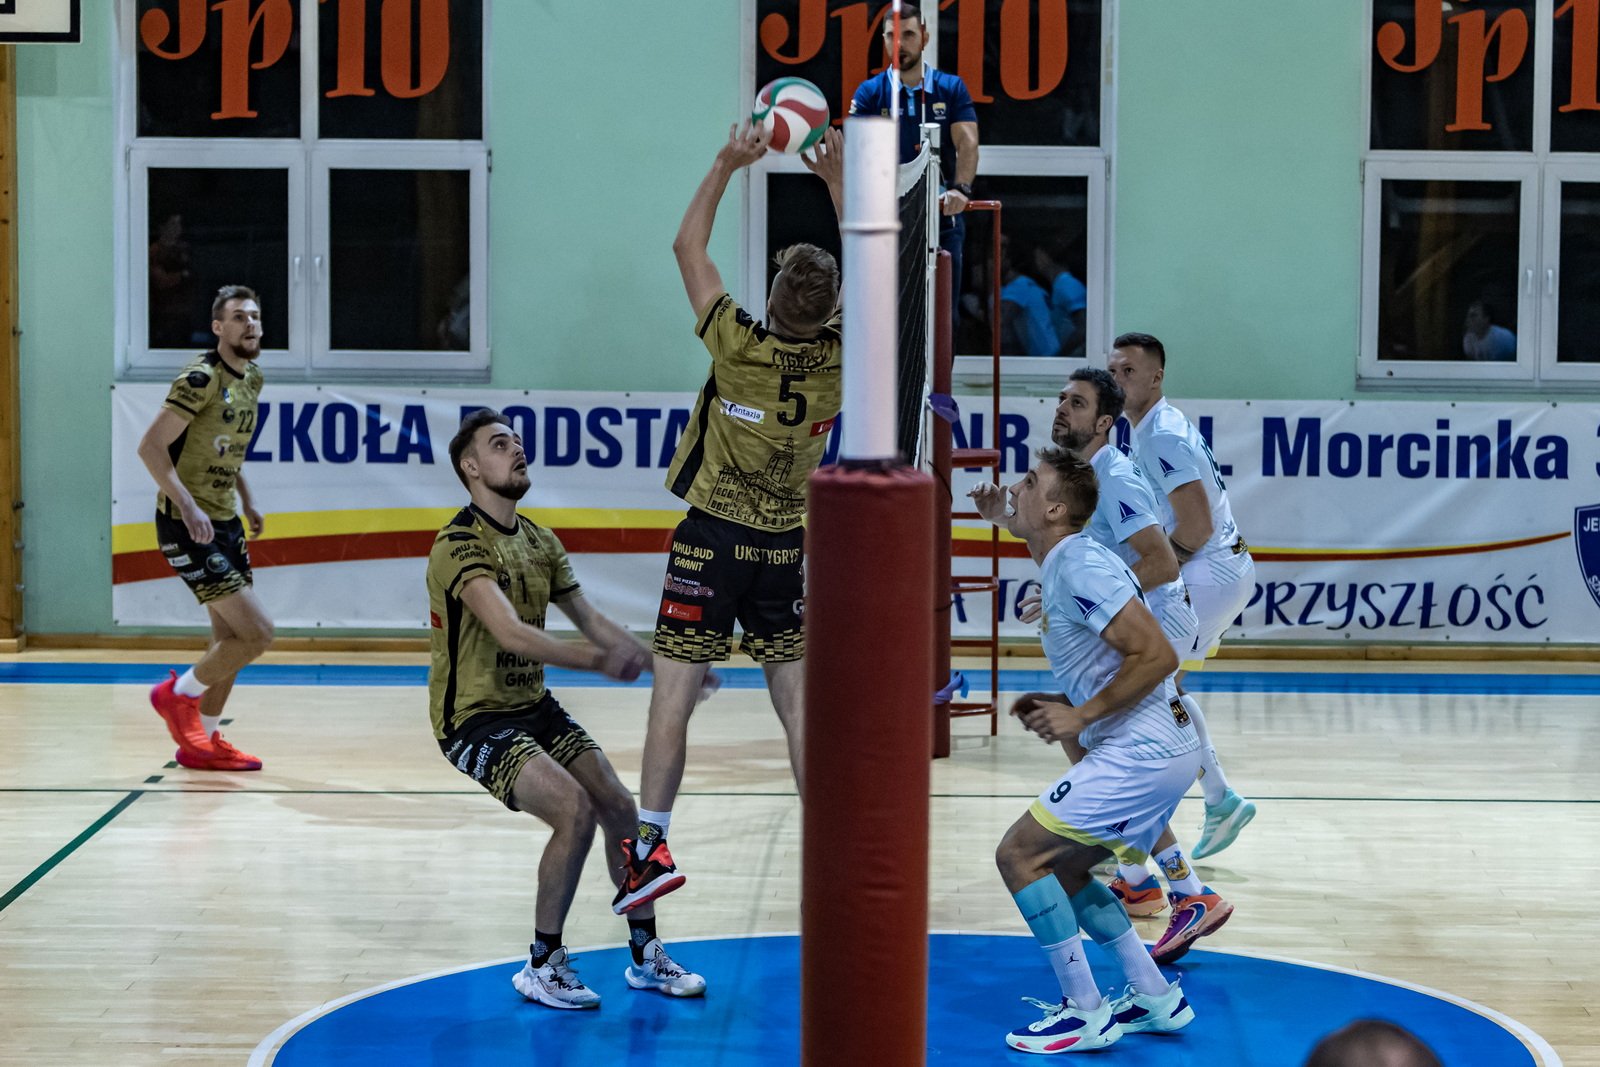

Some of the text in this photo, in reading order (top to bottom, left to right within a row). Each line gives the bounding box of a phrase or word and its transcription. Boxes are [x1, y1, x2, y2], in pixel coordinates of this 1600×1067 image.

[777, 374, 807, 426] 5
[236, 410, 255, 434] 22
[244, 402, 435, 465] ZKOŁA
[952, 413, 1030, 473] NR
[1262, 417, 1569, 480] Morcinka
[1583, 516, 1600, 533] JE
[672, 540, 714, 560] KAW-BUD
[674, 556, 704, 572] GRANIT
[517, 573, 528, 604] 1
[1233, 573, 1549, 631] PRZYSZŁOŚĆ
[1049, 780, 1072, 804] 9
